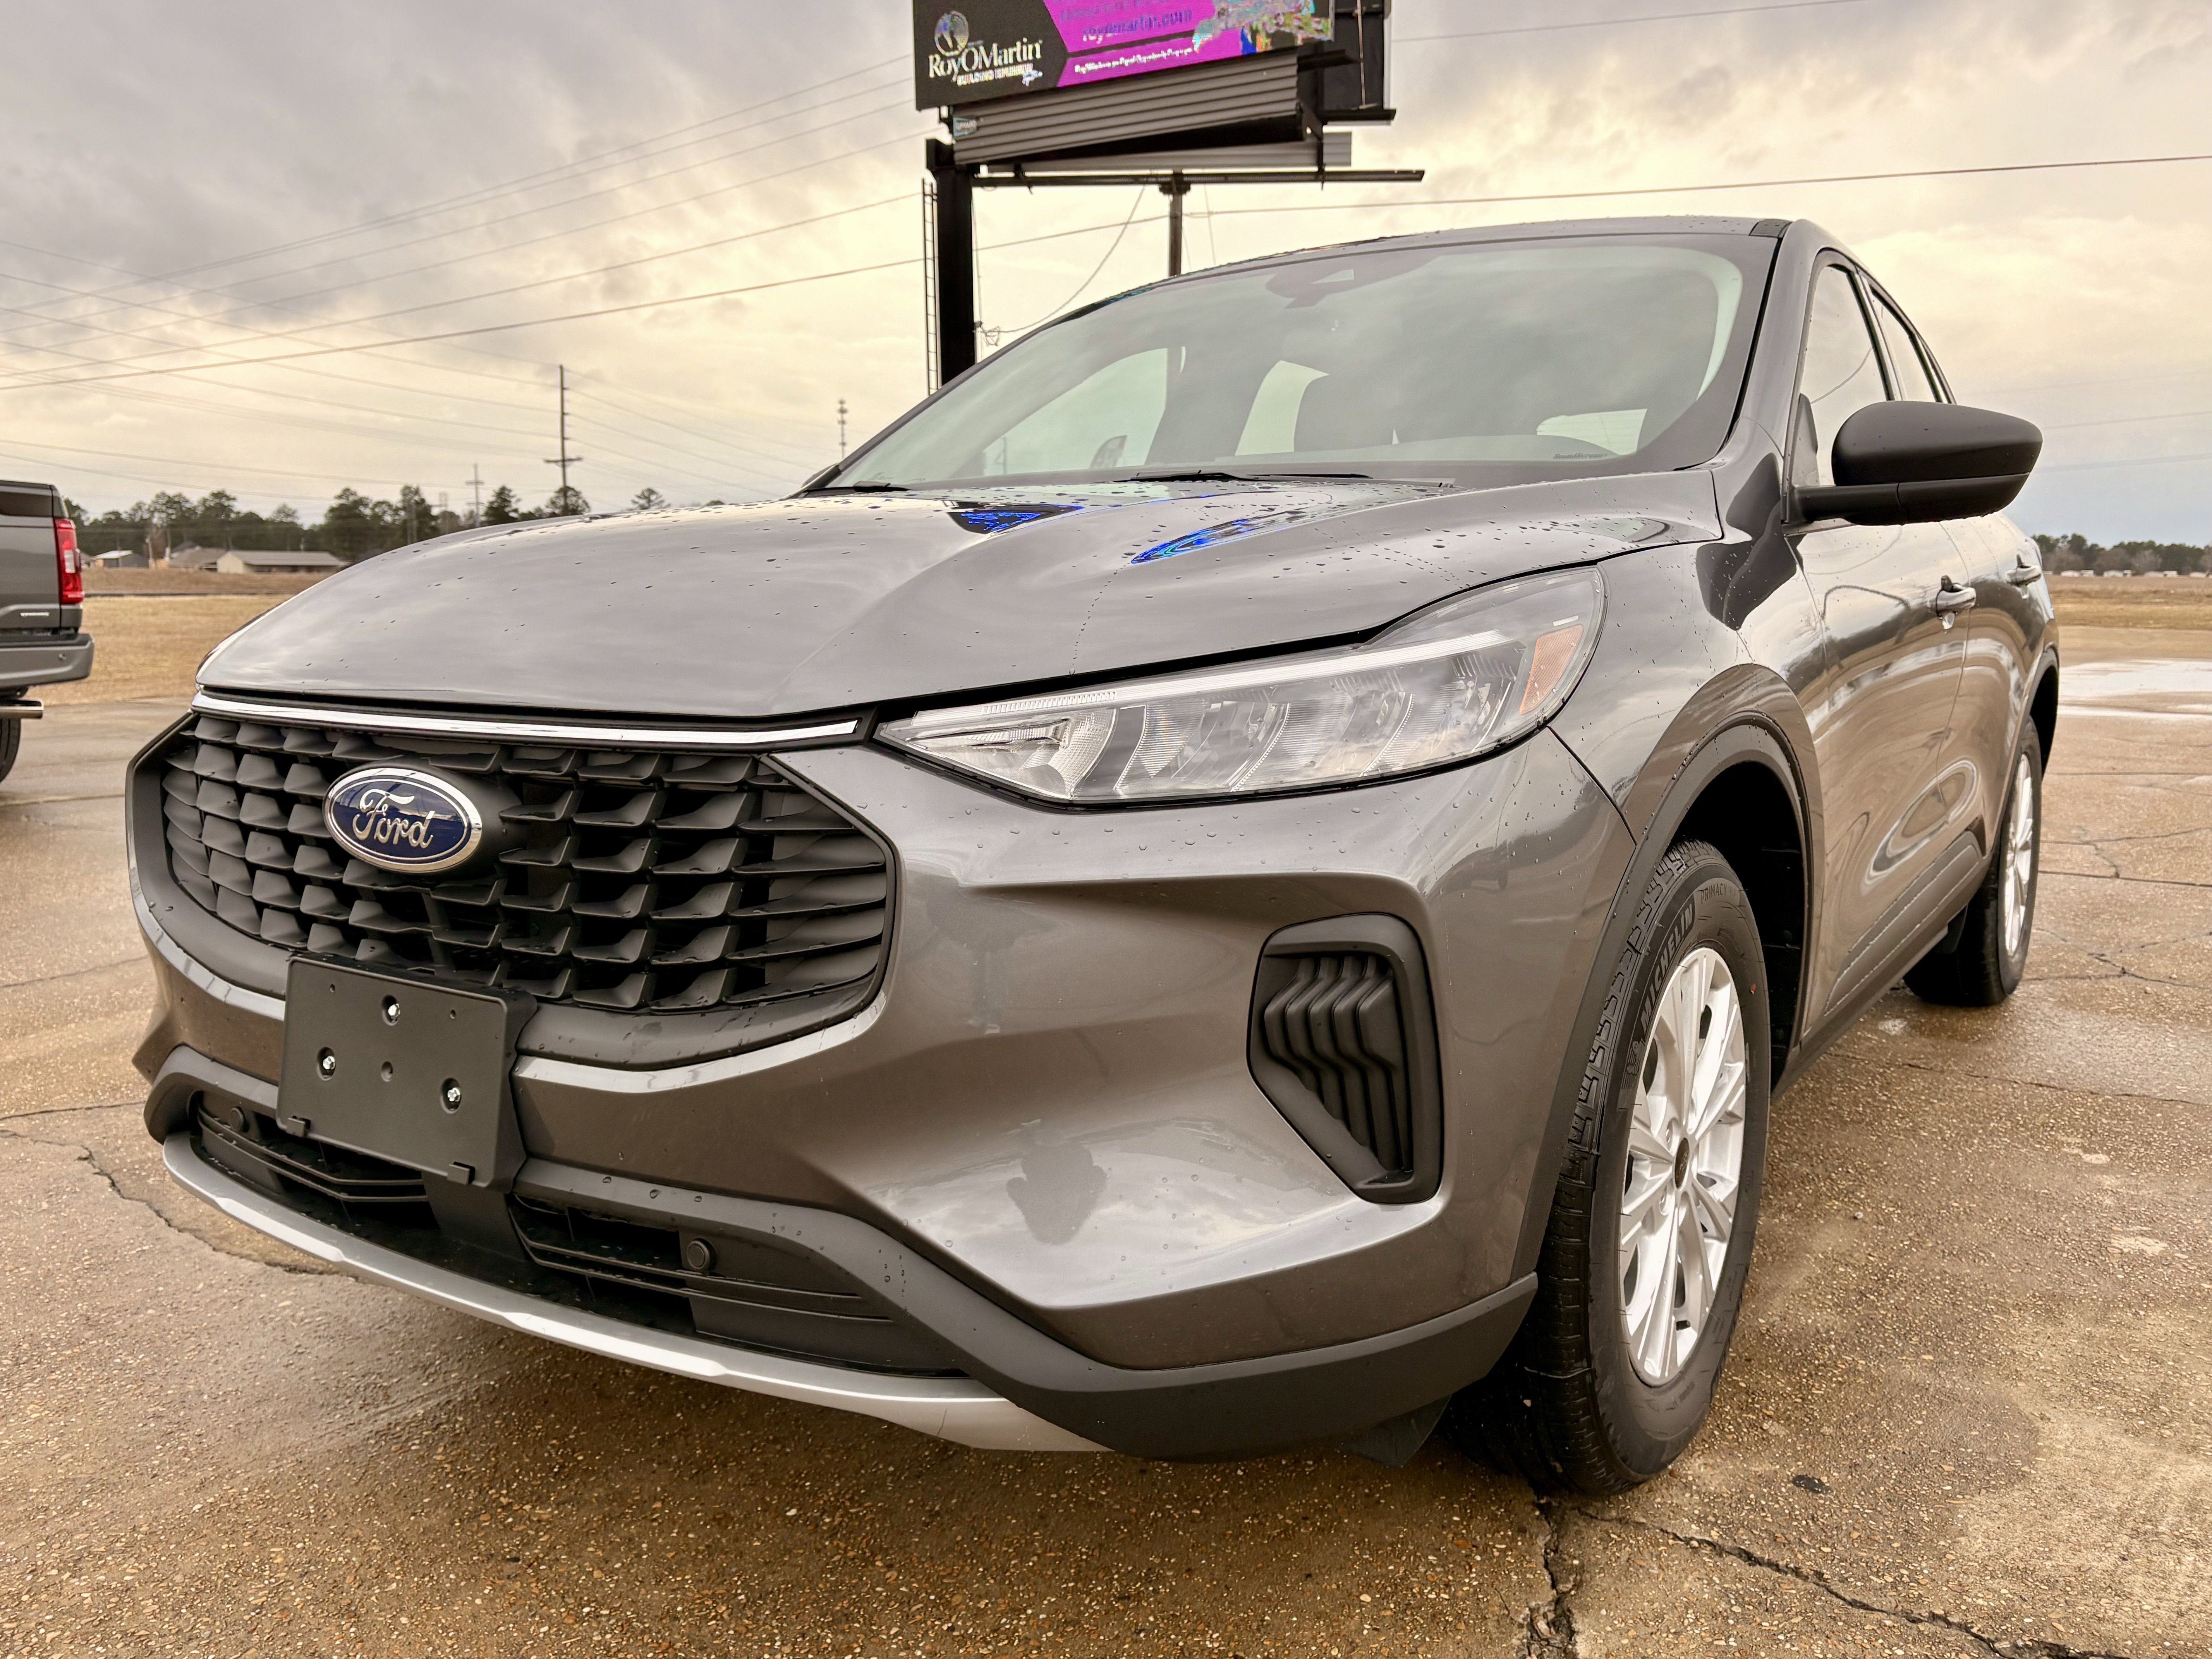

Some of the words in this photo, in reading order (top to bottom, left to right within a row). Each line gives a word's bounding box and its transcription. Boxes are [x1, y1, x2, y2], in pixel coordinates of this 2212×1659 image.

[928, 37, 1041, 82] RoyOMartin
[352, 789, 435, 848] Ford
[1700, 883, 1727, 904] PRIMACY
[1640, 903, 1693, 1034] MICHELIN
